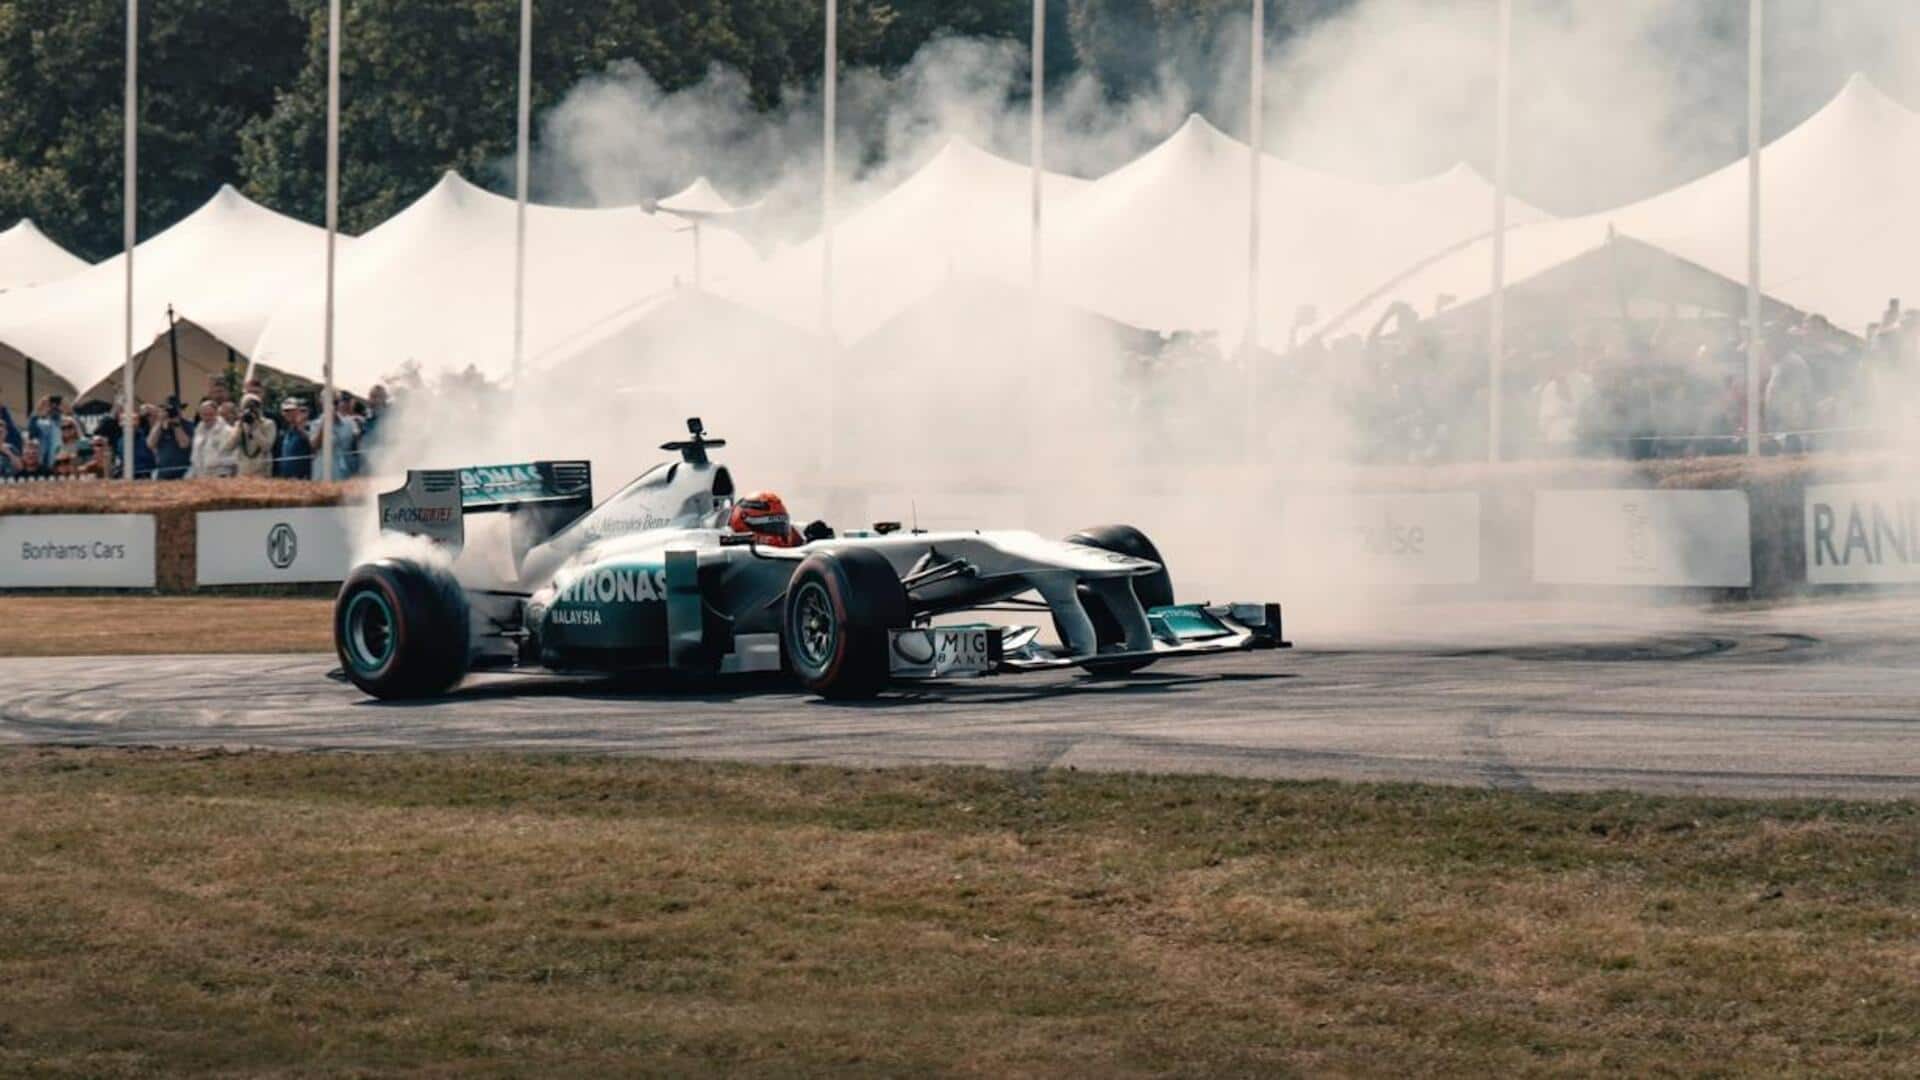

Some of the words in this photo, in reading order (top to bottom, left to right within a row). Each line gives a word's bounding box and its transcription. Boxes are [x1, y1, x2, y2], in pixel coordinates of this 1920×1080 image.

[1813, 501, 1920, 566] RAN
[22, 541, 87, 560] Bonhams
[93, 540, 125, 559] Cars
[551, 609, 602, 625] MALAYSIA
[941, 632, 985, 653] MIG
